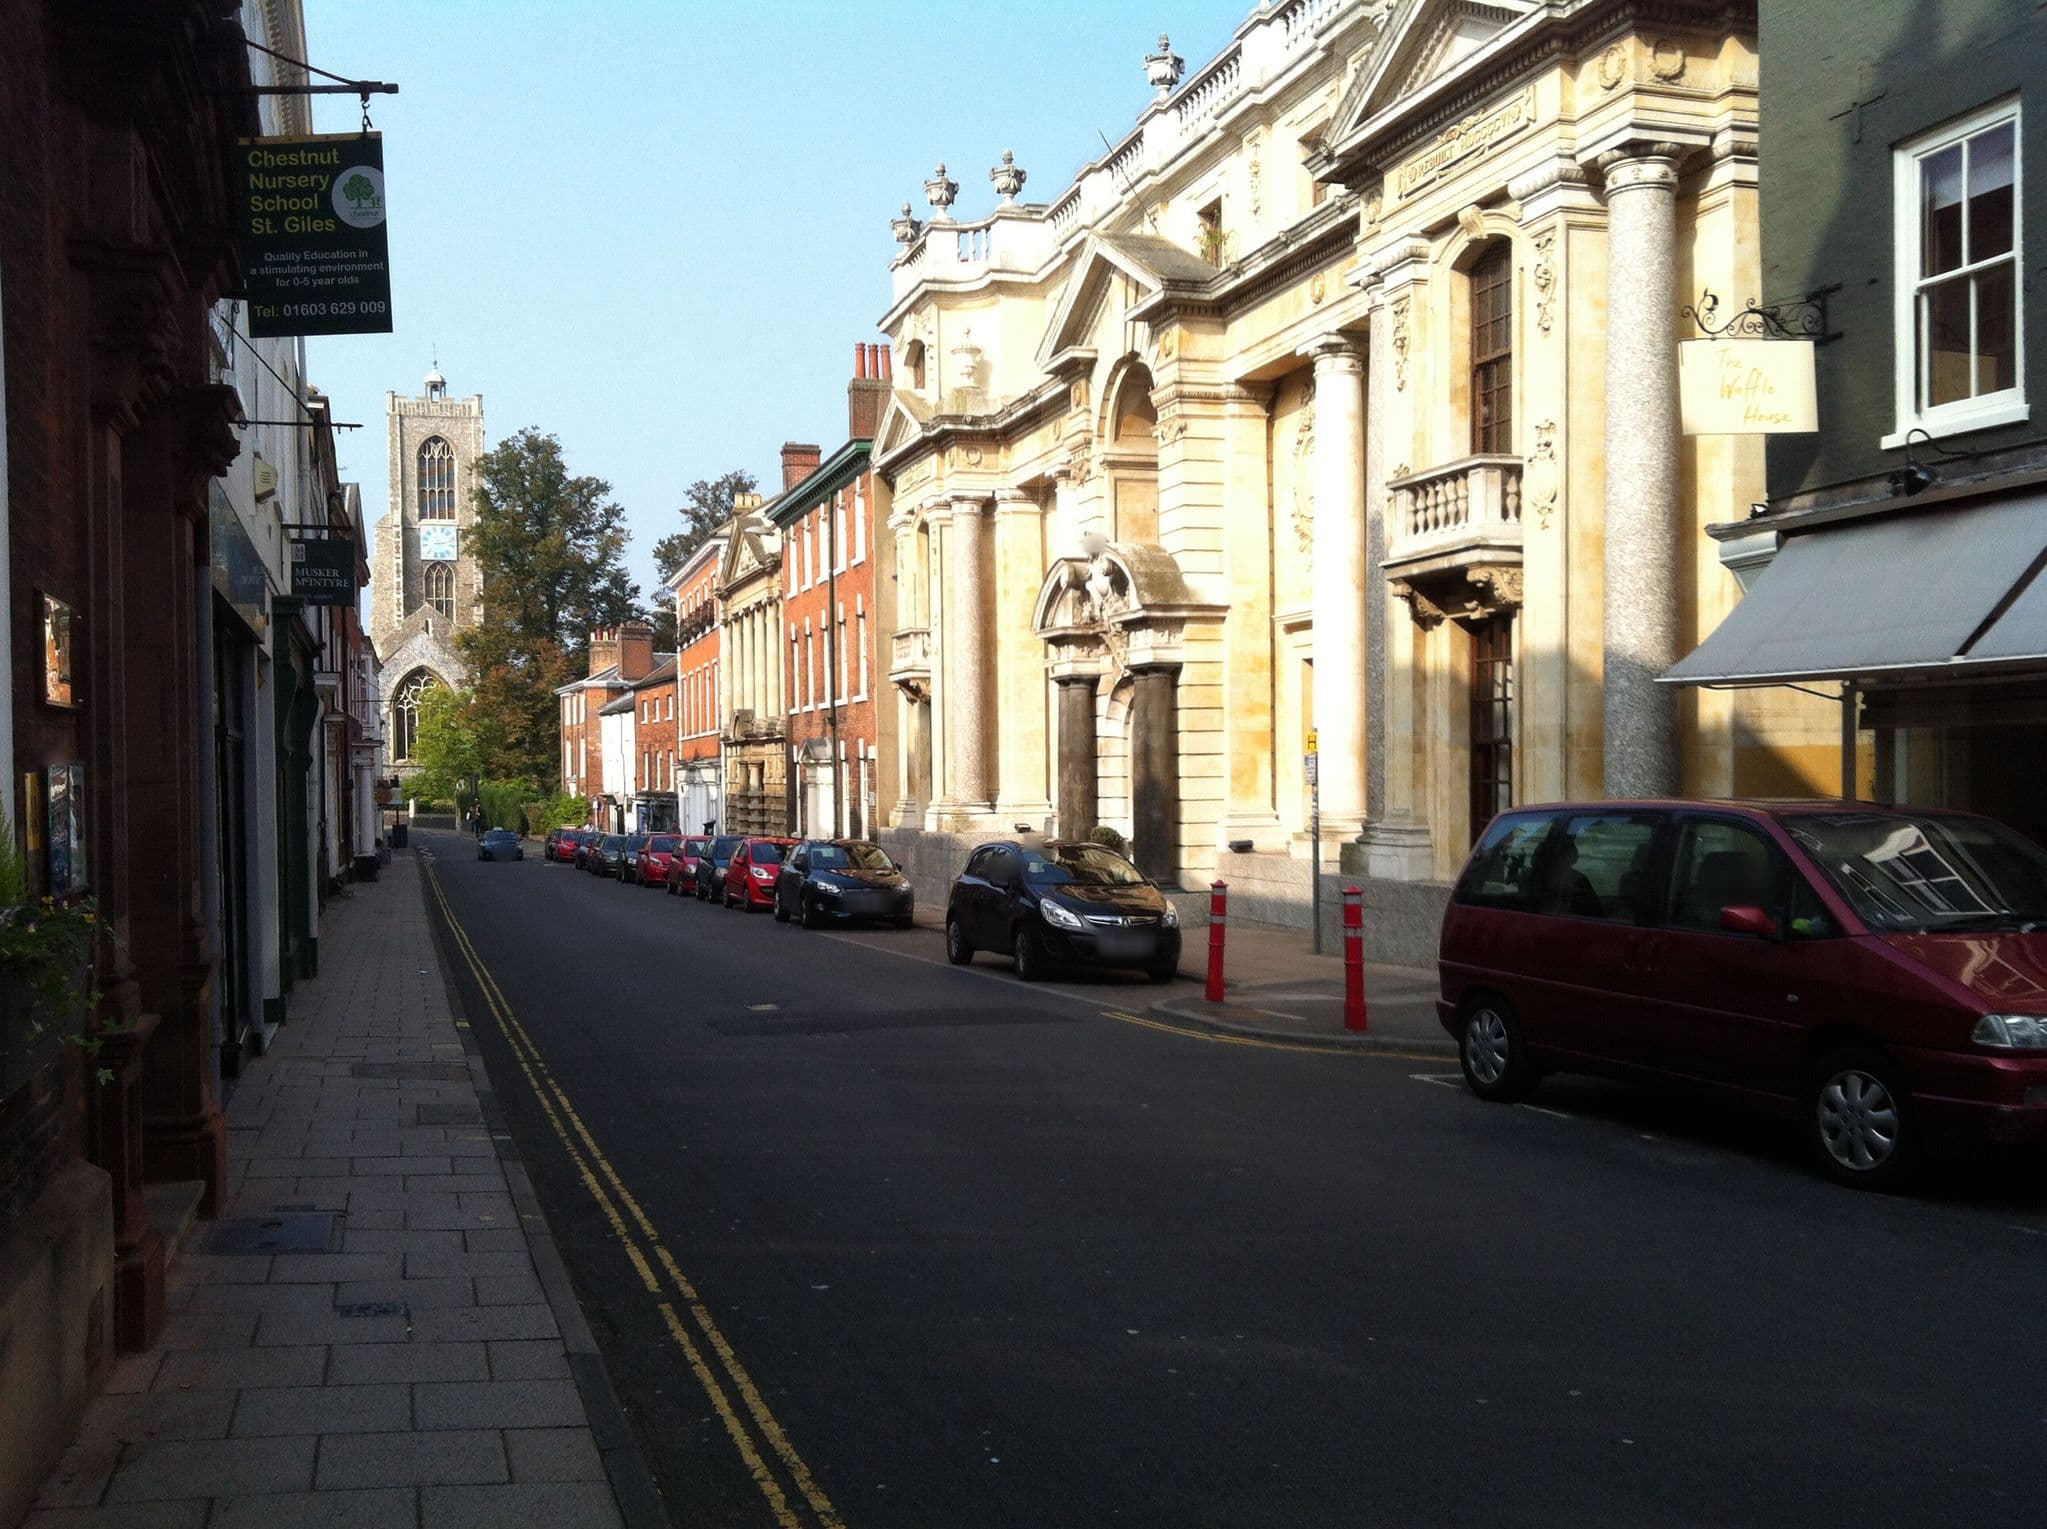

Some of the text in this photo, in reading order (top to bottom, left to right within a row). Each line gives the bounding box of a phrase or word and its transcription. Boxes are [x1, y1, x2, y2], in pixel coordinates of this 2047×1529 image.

[248, 148, 340, 167] Chestnut
[249, 173, 330, 190] Nursery
[250, 193, 319, 212] School
[251, 215, 336, 234] St. Giles
[264, 249, 368, 263] Quality Education in
[259, 263, 317, 275] stimulating
[318, 261, 384, 273] environment
[275, 275, 360, 287] for 0-5 year olds
[283, 303, 326, 317] 01603
[330, 302, 356, 315] 629
[360, 301, 386, 313] 009
[1743, 404, 1792, 426] House
[295, 567, 340, 578] MUSKER
[1307, 735, 1317, 749] H
